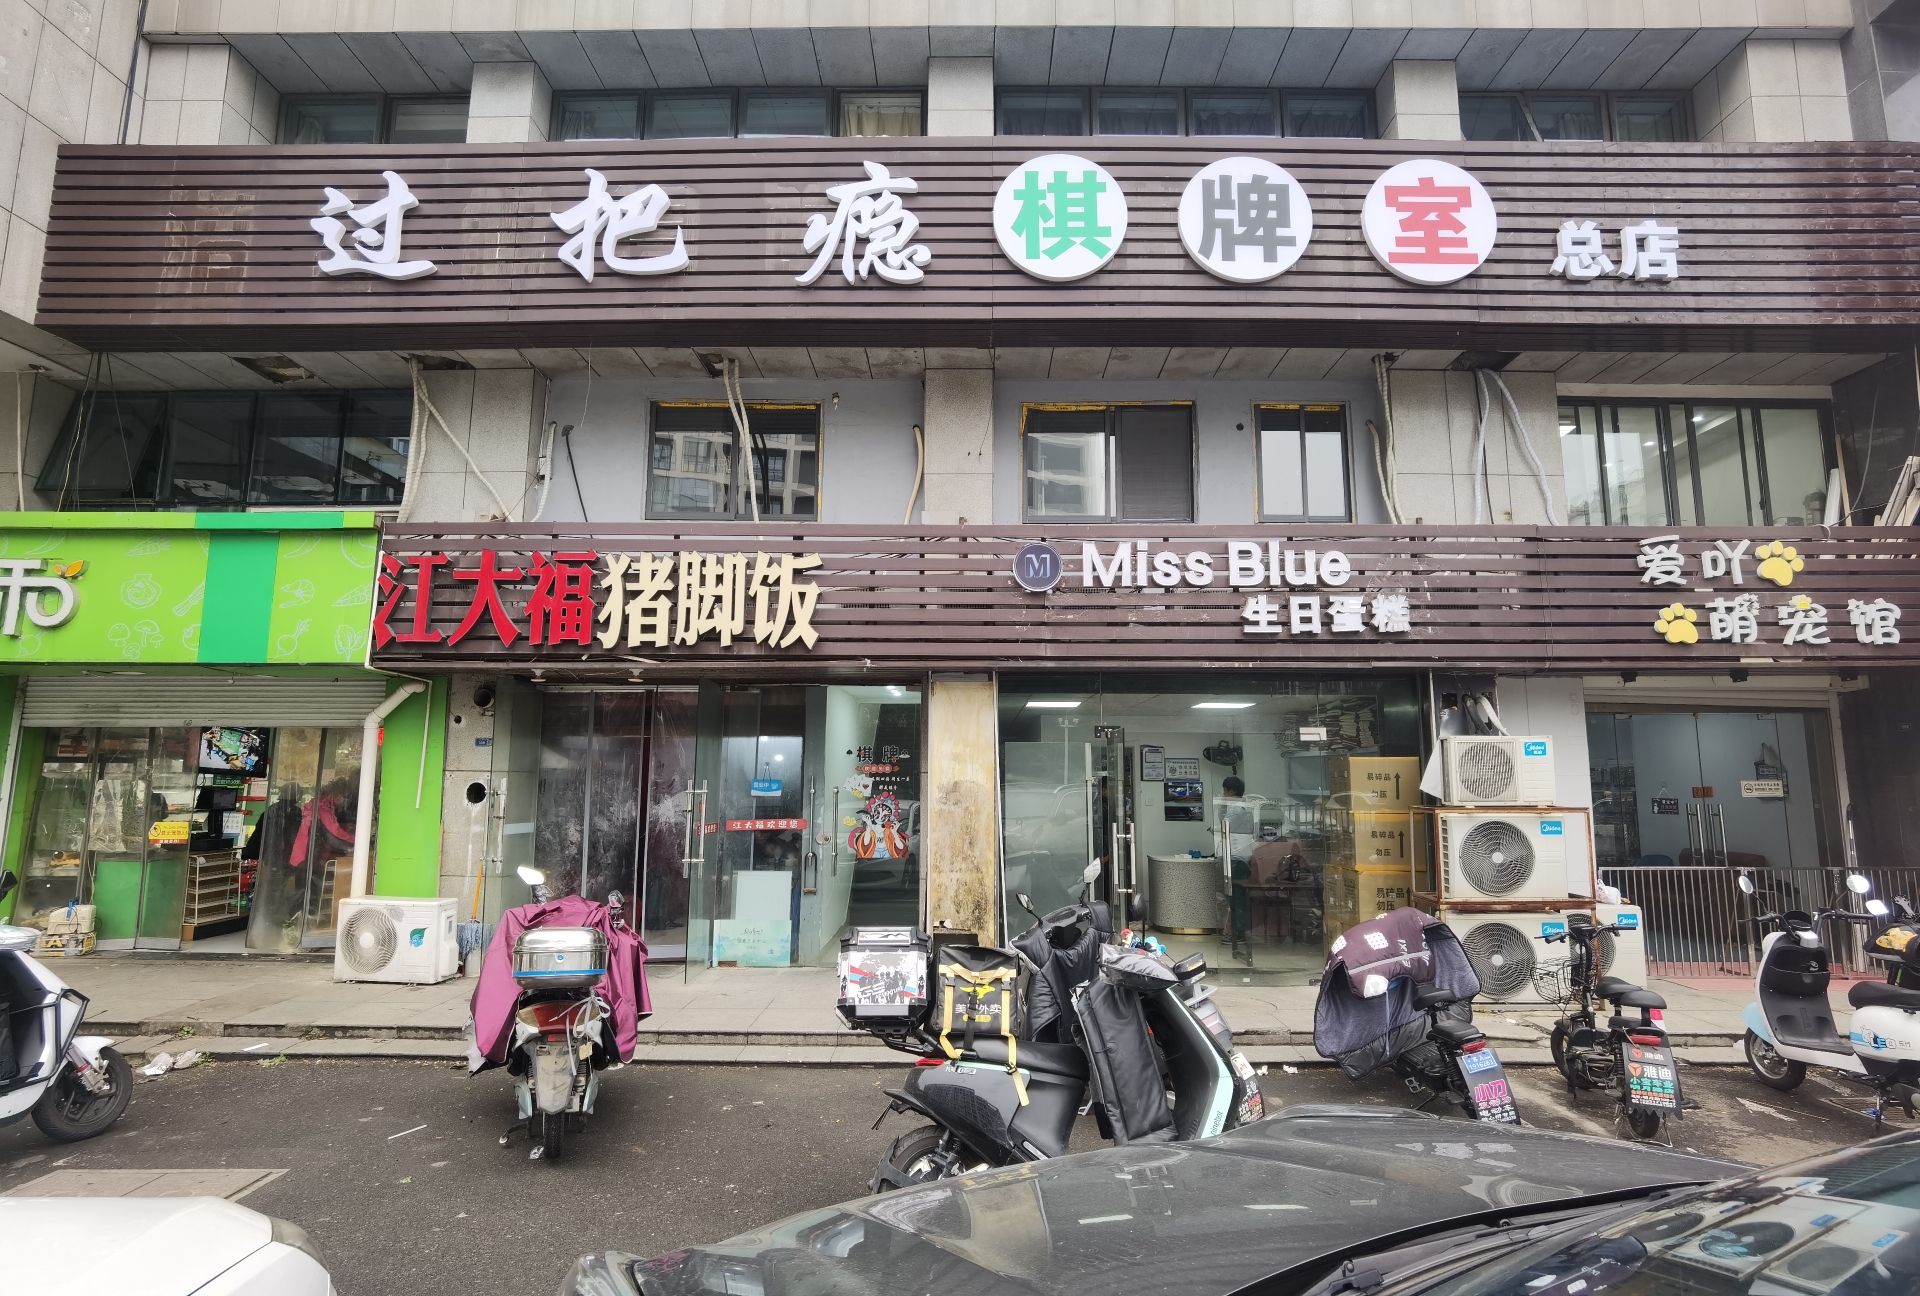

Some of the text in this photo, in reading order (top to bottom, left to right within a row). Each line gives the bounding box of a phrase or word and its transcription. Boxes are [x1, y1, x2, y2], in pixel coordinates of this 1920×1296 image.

[309, 160, 933, 287] 过把瘾
[1548, 219, 1680, 282] 总店
[1081, 540, 1352, 587] Miss Blue
[373, 548, 825, 651] 江大福猪脚饭
[1241, 594, 1411, 635] 生日蛋糕
[1705, 592, 1902, 645] 萌宠馆
[1526, 742, 1545, 752] Midea
[857, 744, 900, 763] 棋牌
[1367, 773, 1391, 781] 易碎品
[732, 819, 798, 829] 江大福欢迎您
[1541, 823, 1561, 832] Midea
[1371, 831, 1395, 839] 易碎品
[1375, 848, 1391, 857] 勿压
[1376, 888, 1405, 899] 易碎品
[1376, 900, 1395, 911] 勿压
[1618, 916, 1637, 925] Midea
[955, 1003, 1002, 1015] 美外卖
[1643, 1065, 1673, 1081] 雅迪
[1474, 1079, 1507, 1103] 小刀
